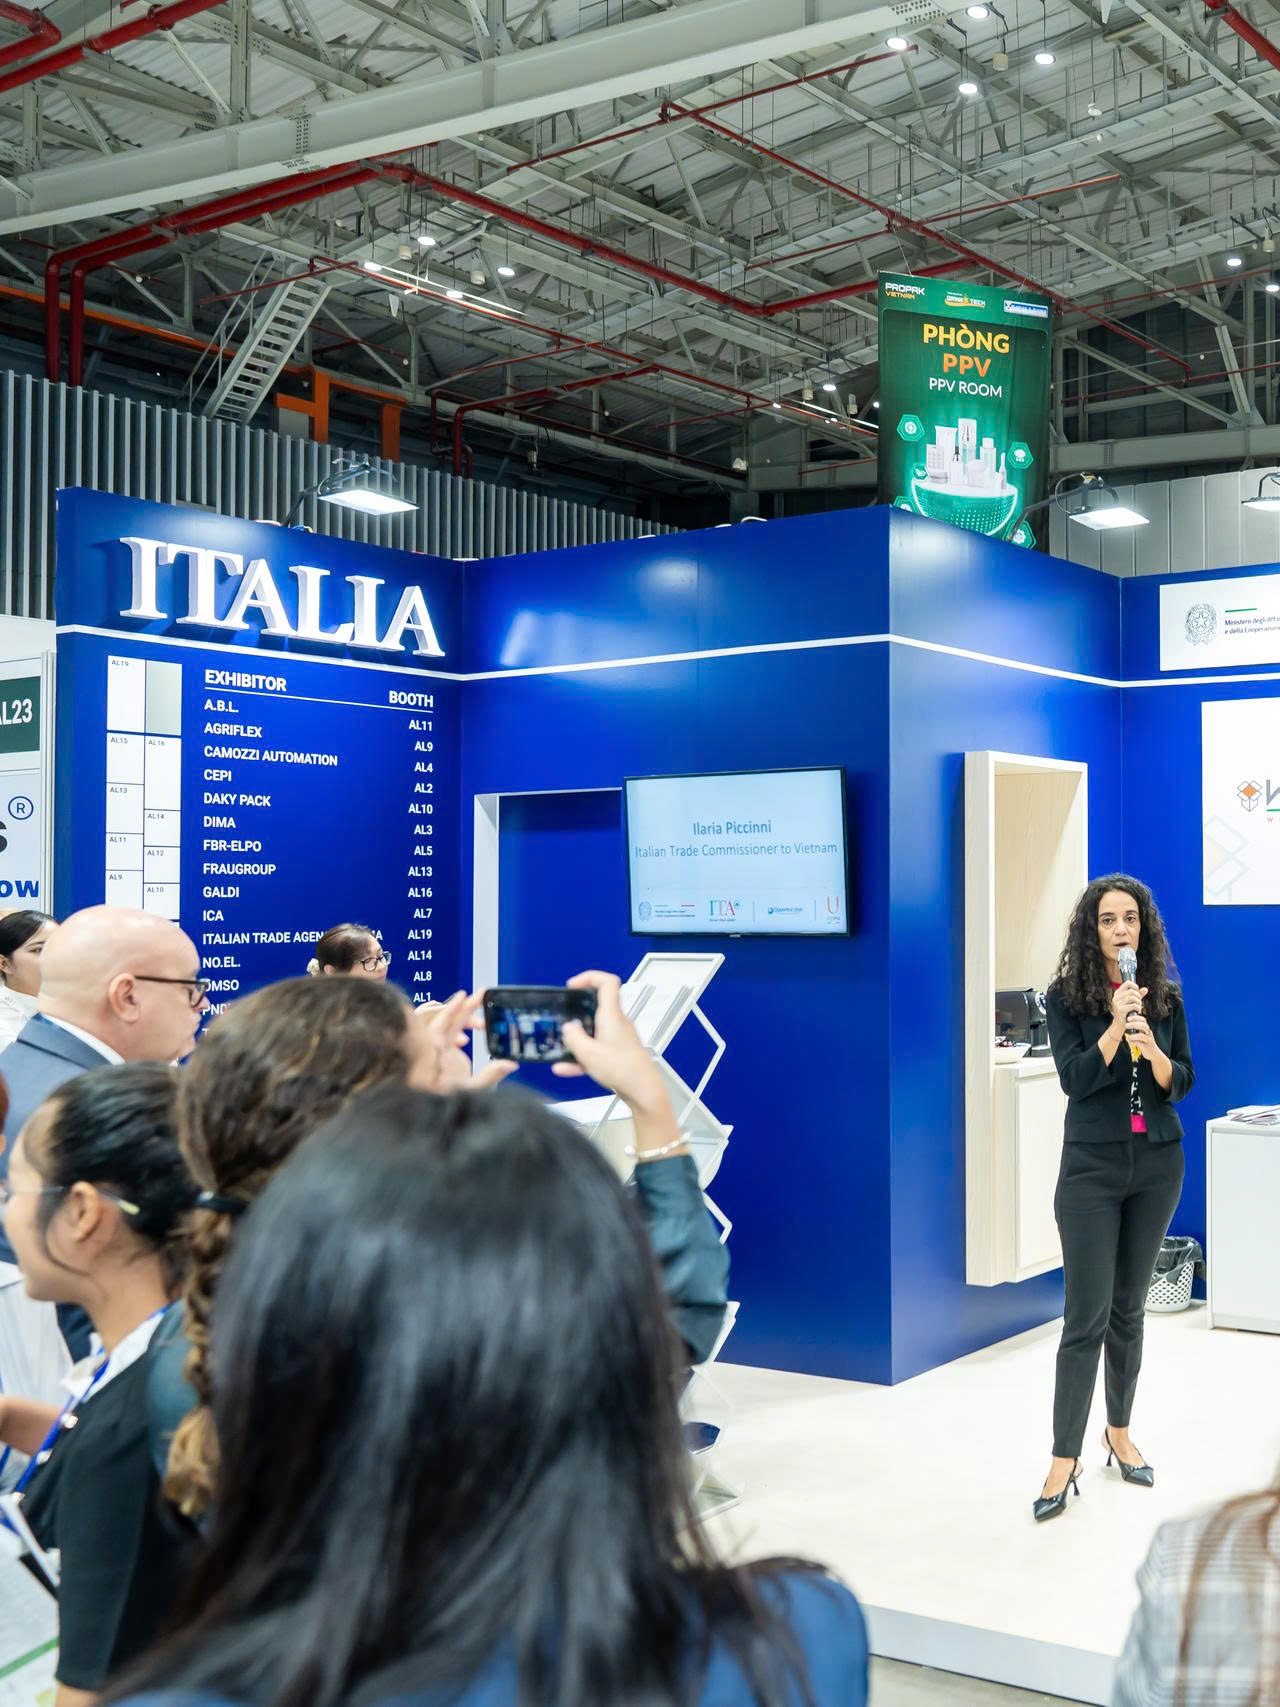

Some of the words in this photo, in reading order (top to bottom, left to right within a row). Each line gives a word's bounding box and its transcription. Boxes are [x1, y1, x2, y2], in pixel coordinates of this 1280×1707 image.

[885, 282, 925, 296] PROPAK
[885, 291, 916, 300] VIETNAM
[923, 323, 1010, 354] PHÒNG
[943, 352, 992, 378] PPV
[929, 377, 956, 393] PPV
[958, 380, 1003, 398] ROOM
[119, 536, 446, 658] ITALIA
[111, 659, 129, 667] AL19
[204, 669, 287, 692] EXHIBITOR
[388, 690, 434, 708] BOOTH
[0, 698, 33, 726] L23
[204, 699, 239, 713] A.B.L.
[204, 722, 263, 738] AGRIFLEX
[408, 720, 433, 732] AL11
[414, 740, 434, 752] AL9
[204, 745, 260, 761] CAMOZZI
[262, 751, 338, 766] AUTOMATION
[414, 762, 433, 773] AL4
[204, 769, 232, 782] CEPI
[414, 783, 433, 794] AL2
[203, 793, 237, 805] DAKY
[240, 794, 271, 807] PACK
[408, 803, 433, 814] AL10
[203, 816, 236, 828] DIMA
[693, 822, 722, 836] Ilaria
[726, 820, 772, 835] Piccinni
[414, 825, 433, 835] AL3
[203, 839, 262, 852] FBR-ELPO
[414, 845, 433, 856] AL5
[635, 845, 667, 858] Italian
[670, 844, 699, 857] Trade
[702, 842, 778, 857] Commissioner
[781, 844, 792, 855] to
[794, 841, 838, 855] Vietnam
[203, 863, 277, 875] FRAUGROUP
[408, 866, 433, 877] AL13
[203, 886, 240, 898] GALDI
[408, 887, 433, 898] AL16
[203, 909, 224, 922] ICA
[413, 908, 433, 919] AL7
[202, 932, 250, 945] ITALIAN
[252, 931, 291, 944] TRADE
[293, 931, 328, 943] AGEN
[408, 929, 433, 940] AL19
[407, 950, 433, 961] AL14
[202, 956, 241, 969] NO.EL.
[413, 971, 433, 982] AL8
[413, 992, 432, 1003] AL1
